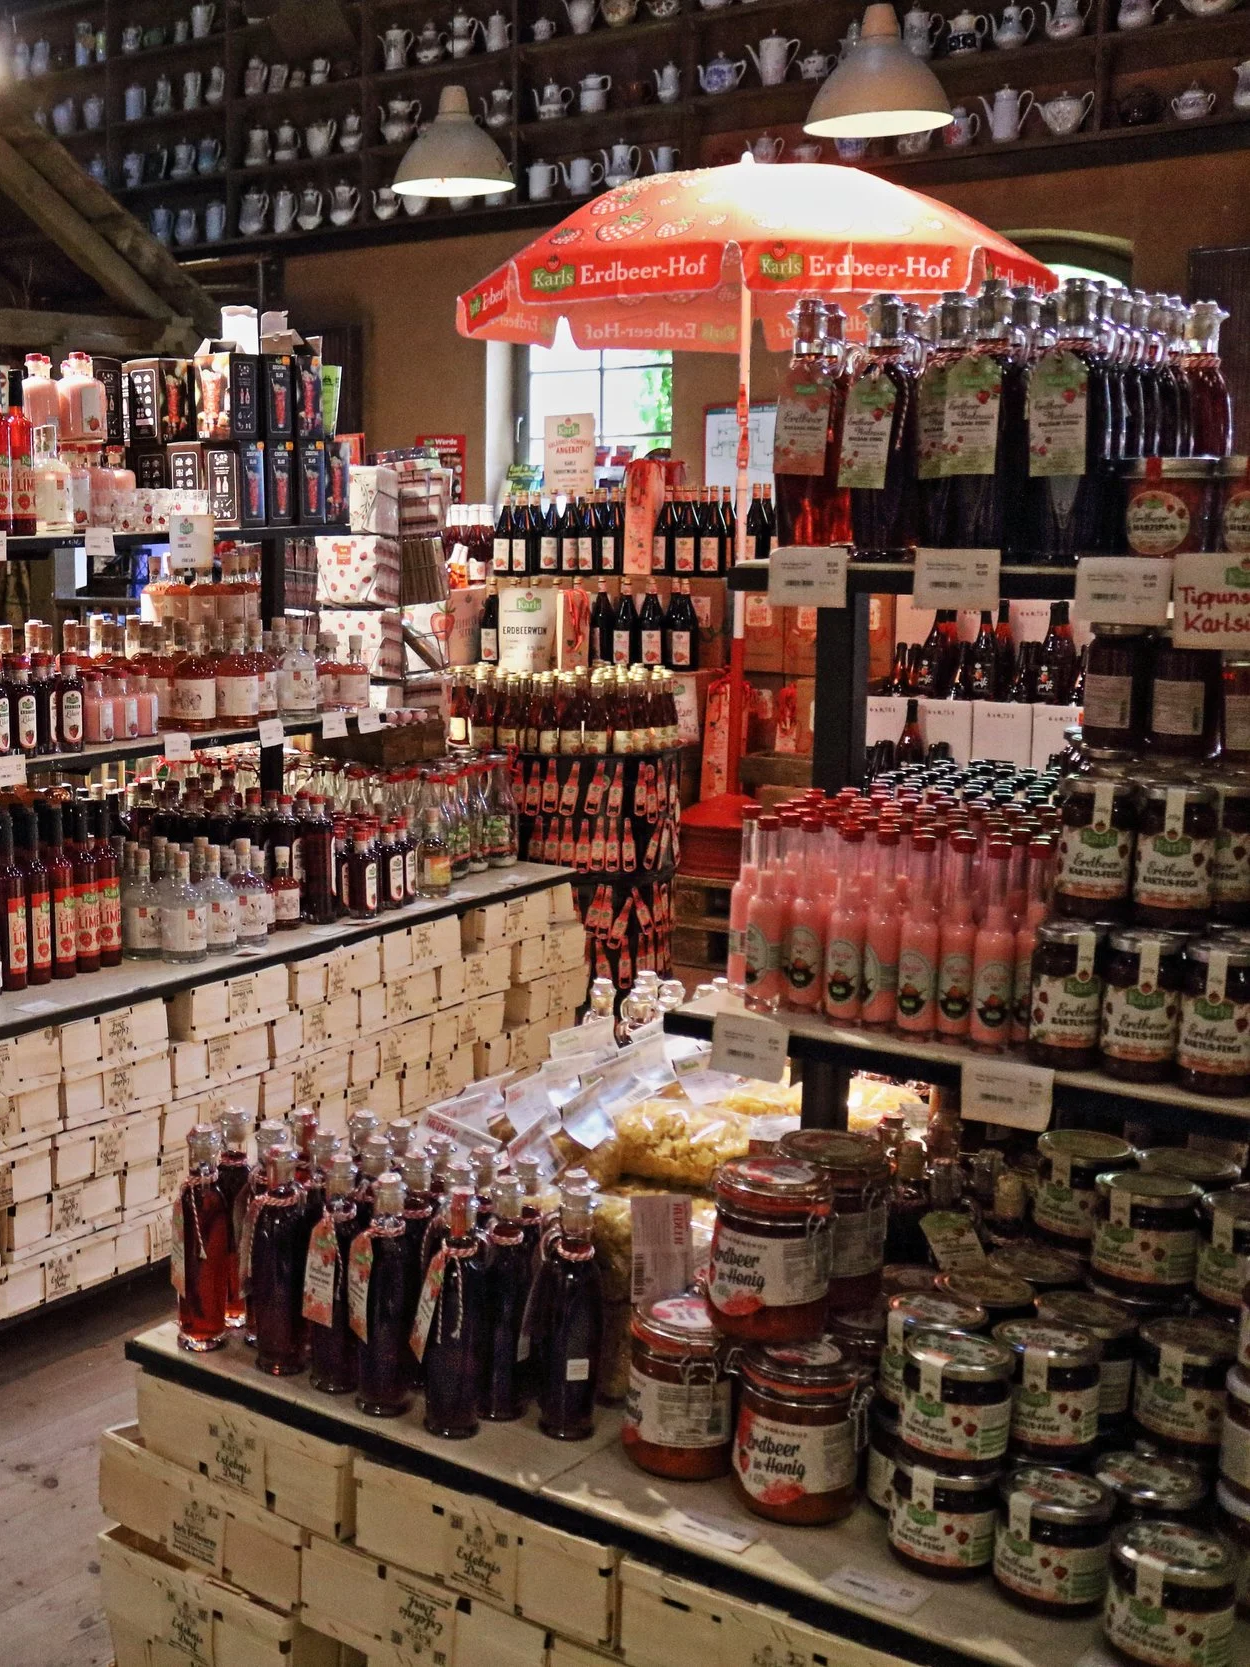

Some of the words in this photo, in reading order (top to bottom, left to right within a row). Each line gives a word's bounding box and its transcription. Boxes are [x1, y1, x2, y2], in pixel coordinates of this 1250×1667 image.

[533, 268, 574, 288] Karls
[581, 255, 708, 285] Erdbeer-Hof
[762, 257, 802, 275] Karls
[809, 254, 952, 277] Erdbeer-Hof
[502, 626, 547, 635] ERDBEERWEIN
[727, 1268, 765, 1294] Honig
[765, 1457, 806, 1482] Honig
[456, 1546, 500, 1573] Erlebnis
[463, 1561, 492, 1585] Dorf
